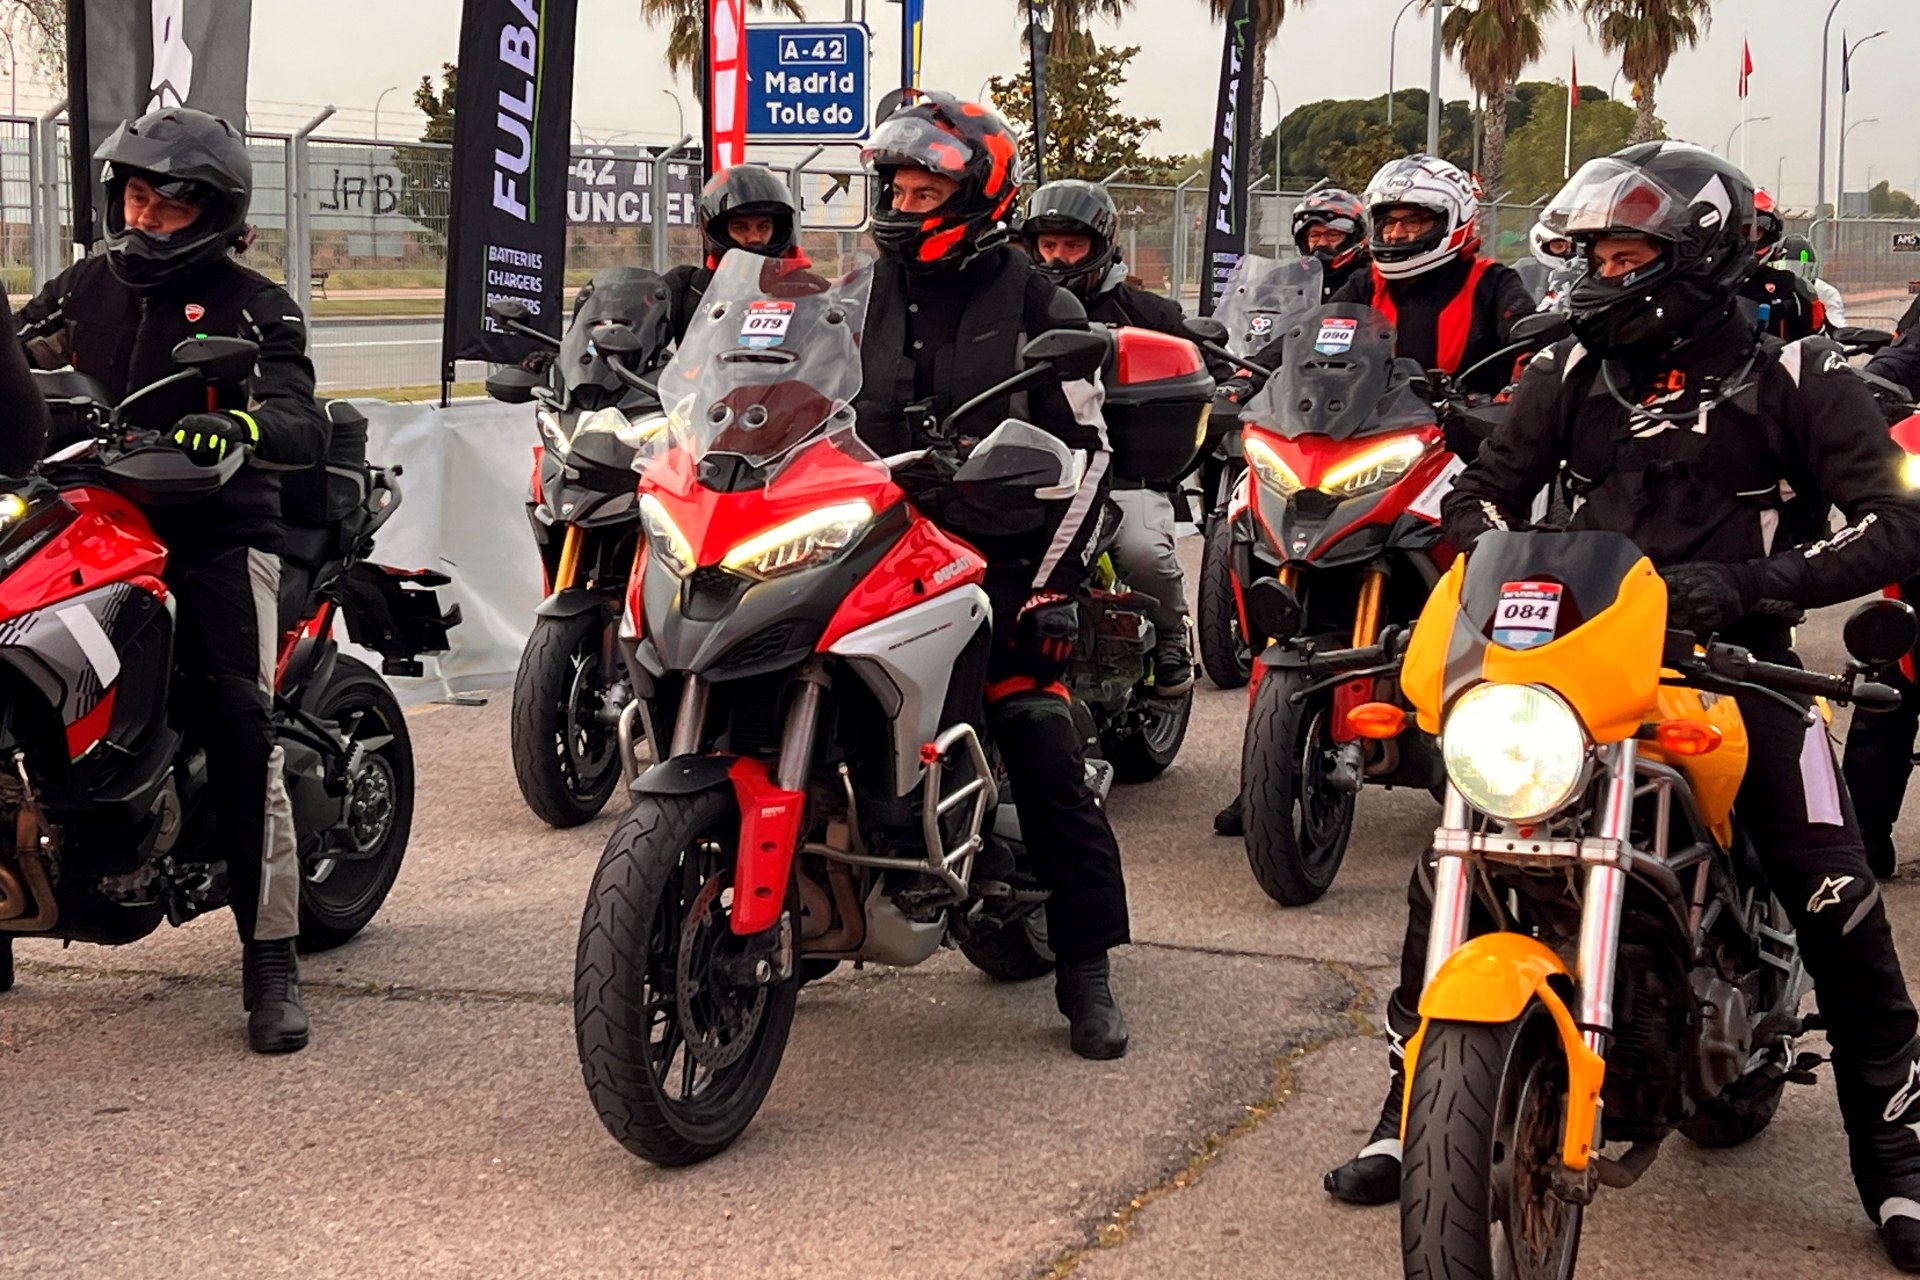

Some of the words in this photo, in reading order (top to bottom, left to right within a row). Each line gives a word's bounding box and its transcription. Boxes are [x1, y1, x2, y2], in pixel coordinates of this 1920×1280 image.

[784, 40, 842, 59] A-42
[765, 70, 854, 94] Madrid
[766, 102, 853, 124] Toledo
[1215, 45, 1241, 235] FULBAT
[489, 245, 542, 270] BATTERIES
[488, 269, 542, 293] CHARGERS
[749, 318, 783, 329] 079
[1504, 604, 1550, 620] 084
